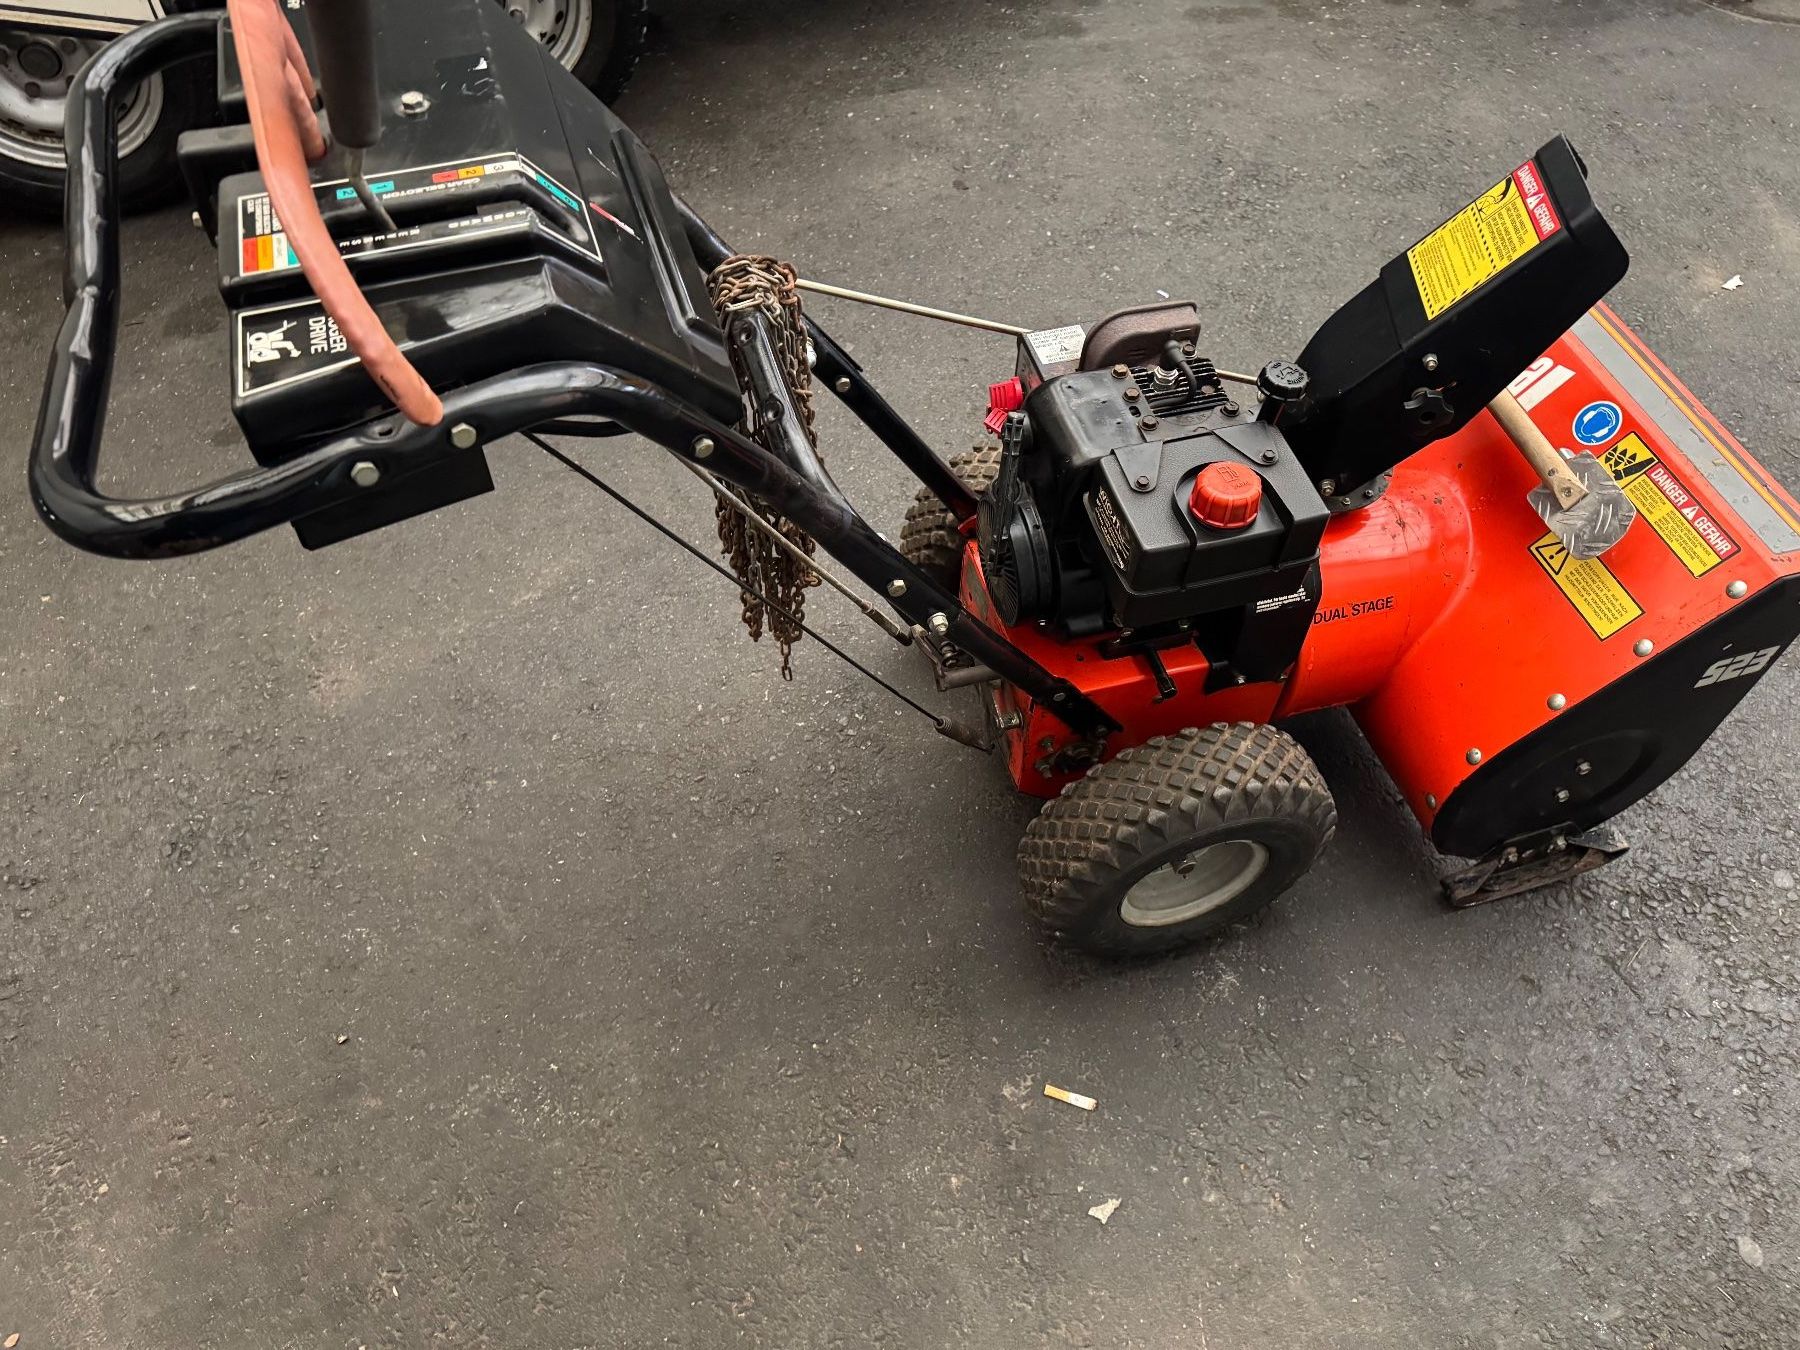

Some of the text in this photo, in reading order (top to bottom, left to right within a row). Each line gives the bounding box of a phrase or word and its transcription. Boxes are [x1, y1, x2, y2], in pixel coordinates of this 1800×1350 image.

[382, 177, 481, 200] GEAR SELECTOR
[1517, 165, 1555, 235] DANGER GEFAHR
[448, 209, 527, 229] FORWARD
[339, 228, 421, 248] REVERSE
[308, 316, 328, 354] DRIVE
[1650, 467, 1689, 507] DANGER
[1694, 516, 1732, 555] GEFAHR
[1313, 595, 1394, 625] DUAL STAGE
